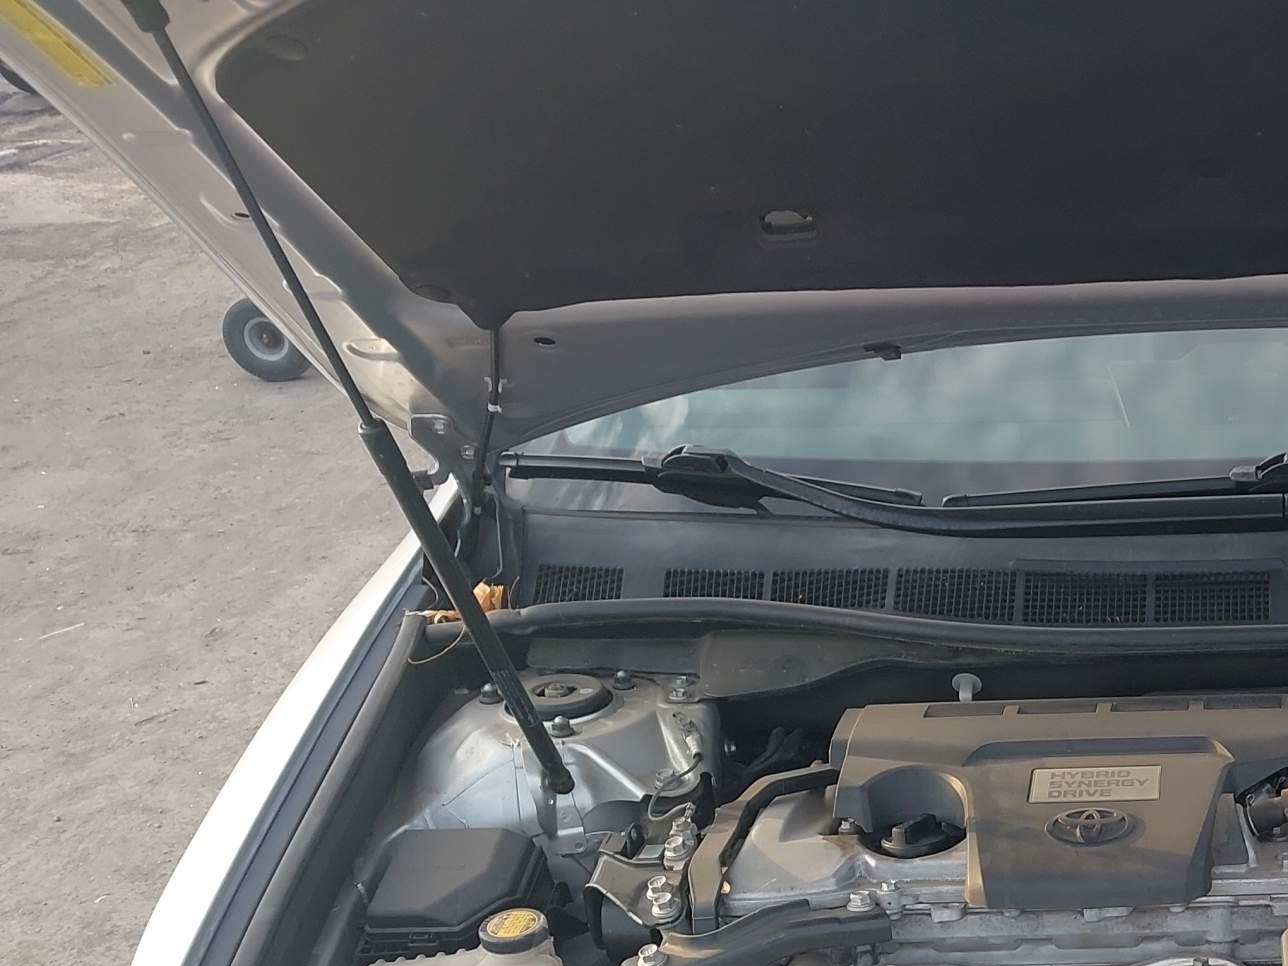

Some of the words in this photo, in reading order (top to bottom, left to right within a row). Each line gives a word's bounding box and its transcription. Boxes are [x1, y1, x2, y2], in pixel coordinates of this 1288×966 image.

[1050, 770, 1131, 779] HYBRID
[1048, 778, 1150, 789] SYNERGY
[1047, 789, 1113, 798] DRIVE
